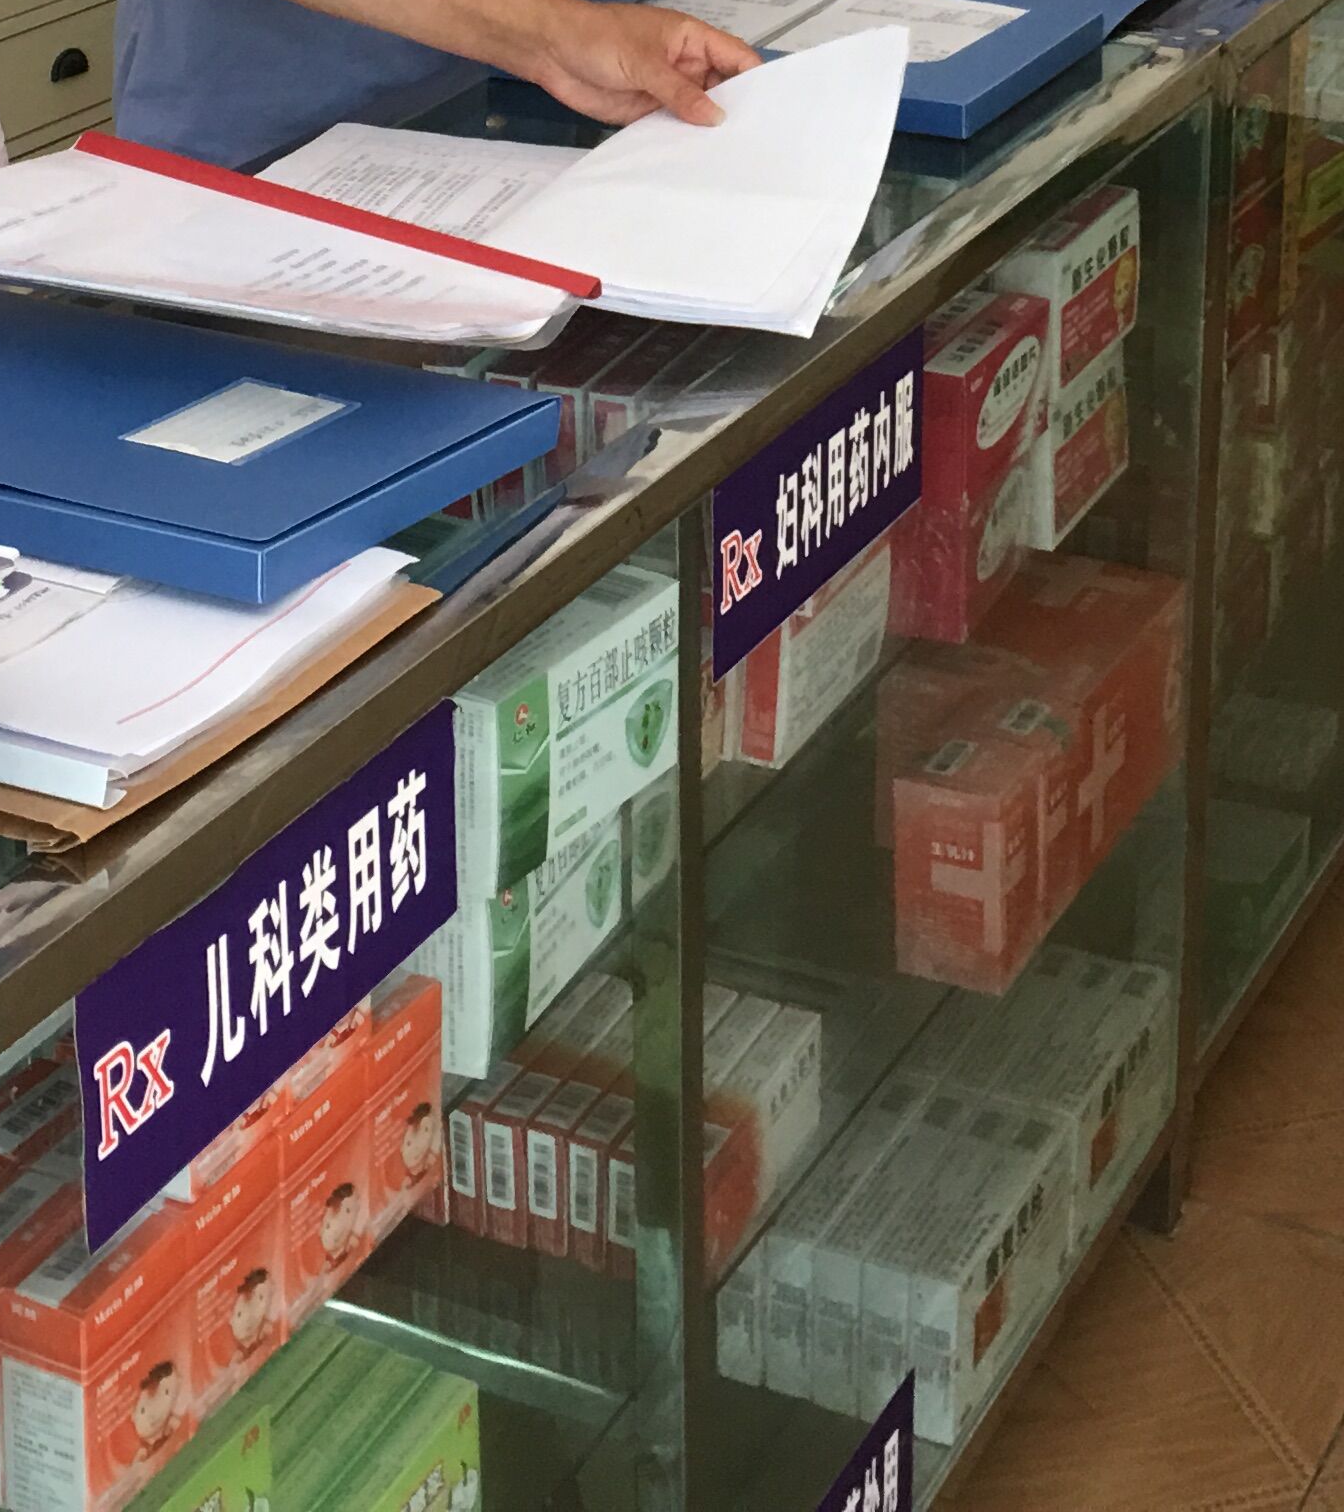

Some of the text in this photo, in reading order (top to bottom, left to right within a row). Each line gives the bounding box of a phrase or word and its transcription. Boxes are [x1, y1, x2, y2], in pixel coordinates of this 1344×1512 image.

[720, 370, 914, 616] Rx 妇科用药内服
[557, 606, 677, 723] 复方百部止咳颗粒
[93, 768, 428, 1162] Rx 儿科类用药
